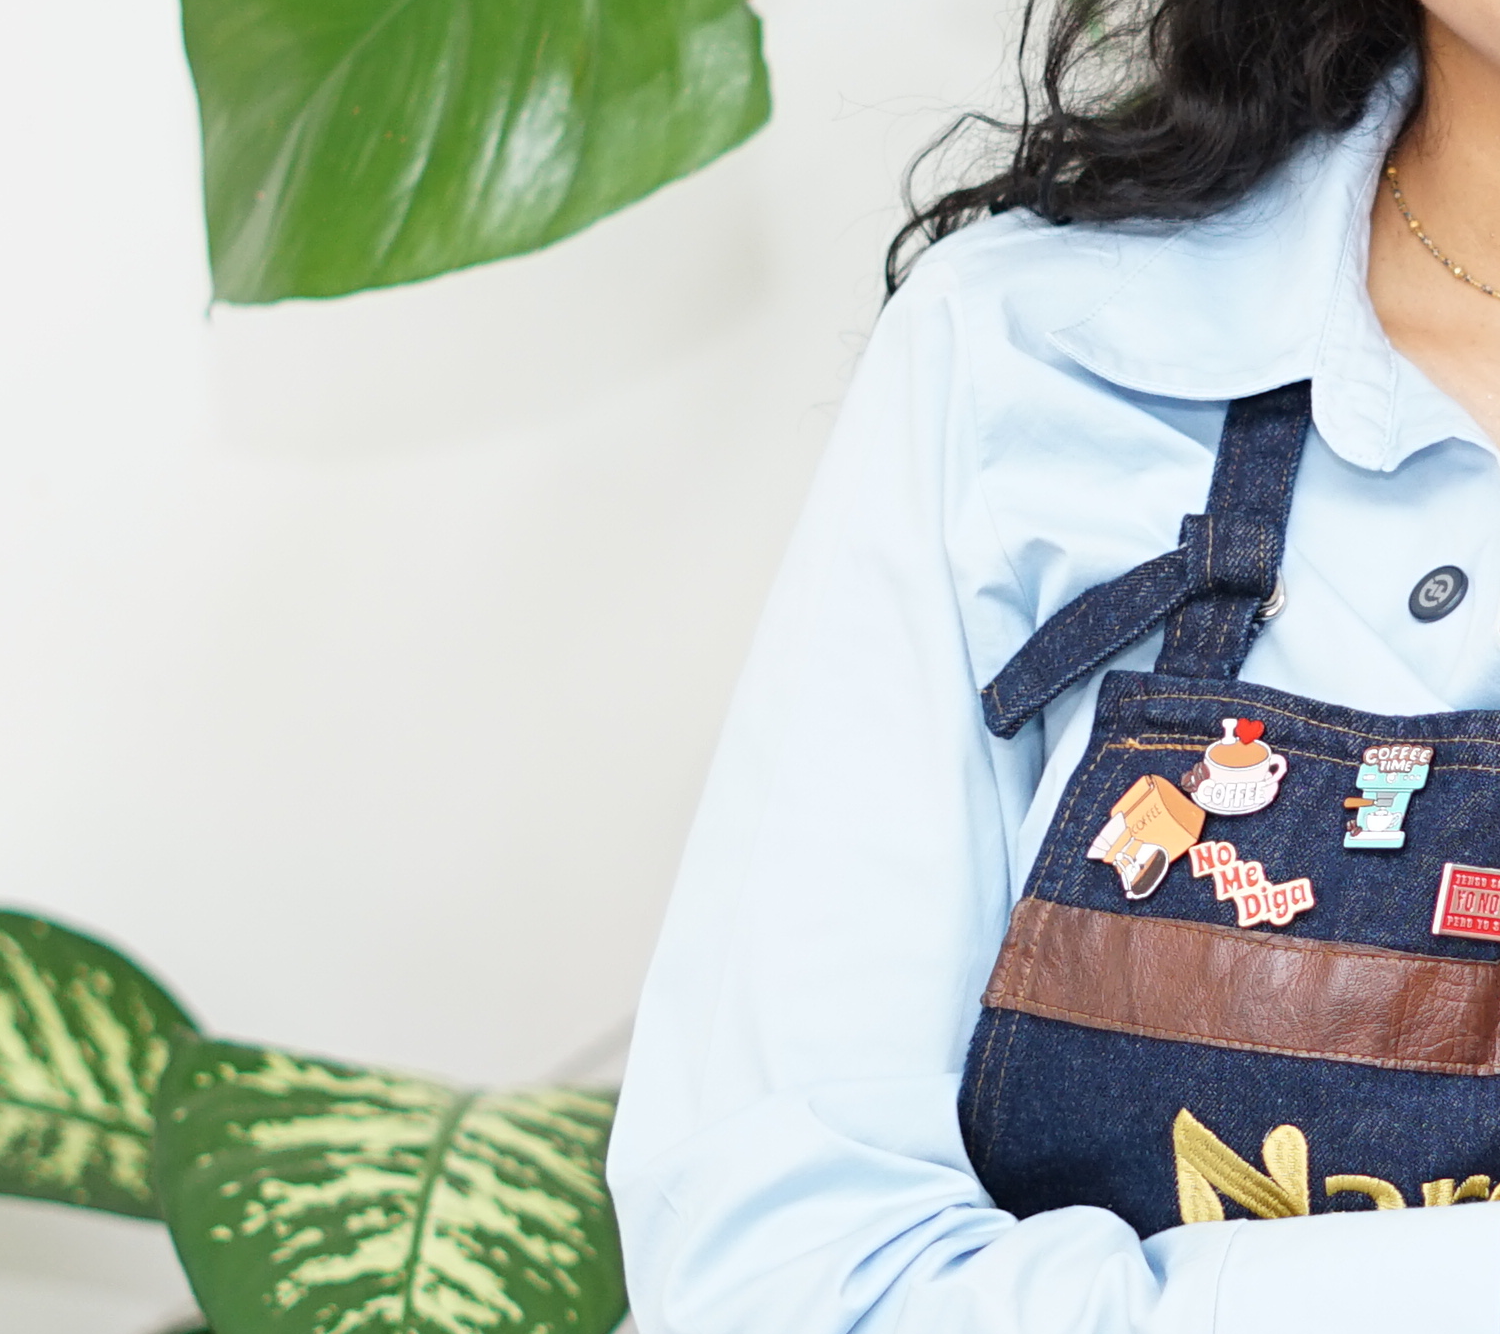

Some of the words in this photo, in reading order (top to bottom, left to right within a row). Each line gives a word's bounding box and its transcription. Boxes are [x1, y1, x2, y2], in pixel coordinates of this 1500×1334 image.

[1364, 746, 1432, 765] COFFEE
[1379, 759, 1414, 772] TIME
[1199, 779, 1267, 809] COFFEE
[1131, 803, 1163, 835] COFFEE
[1219, 864, 1260, 895] Me
[1455, 873, 1488, 888] TENGO
[1242, 882, 1308, 920] Diga
[1457, 889, 1476, 912] YO
[1478, 892, 1500, 915] NO
[1446, 915, 1474, 929] PERO
